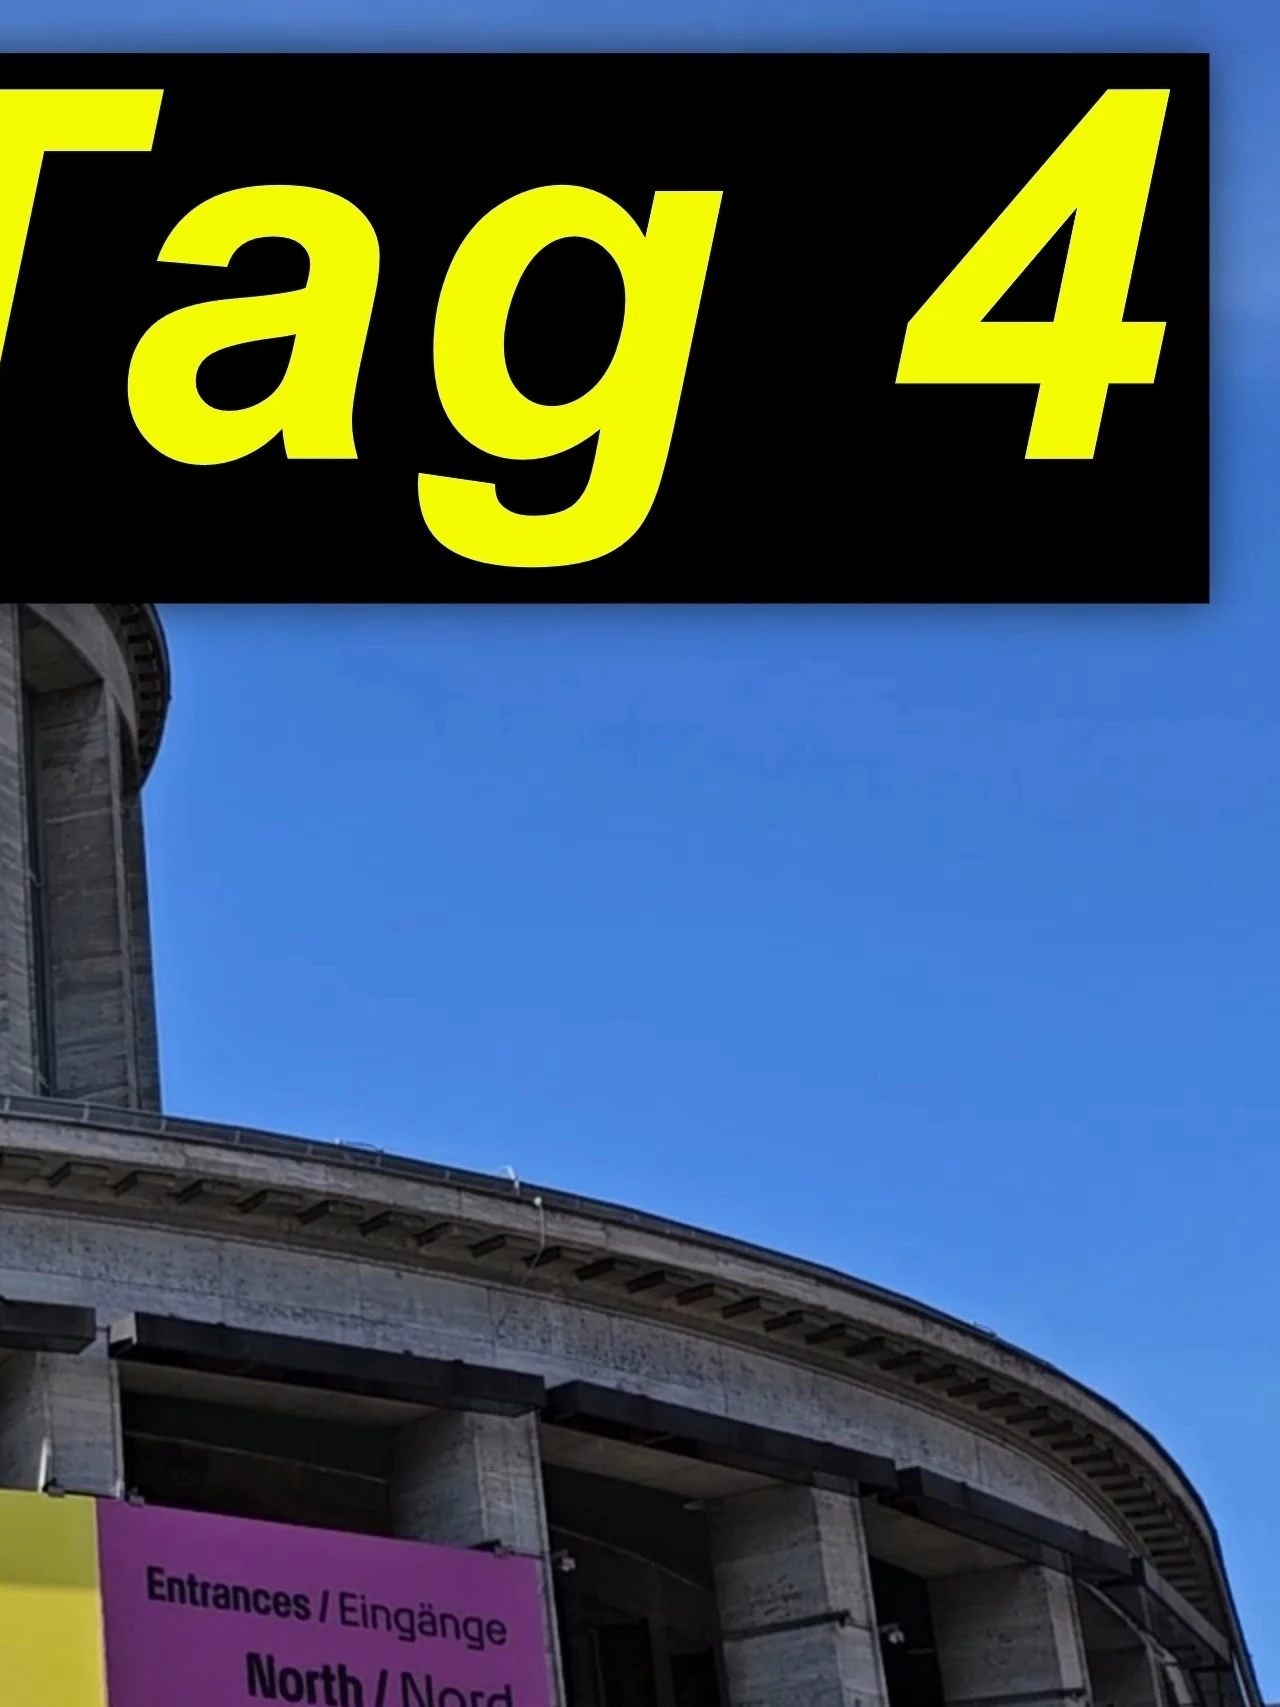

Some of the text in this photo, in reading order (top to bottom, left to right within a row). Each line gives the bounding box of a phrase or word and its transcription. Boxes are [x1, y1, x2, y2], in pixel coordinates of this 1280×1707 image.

[146, 1565, 508, 1651] Entrances / Eingänge
[245, 1651, 364, 1707] North
[374, 1668, 389, 1707] /
